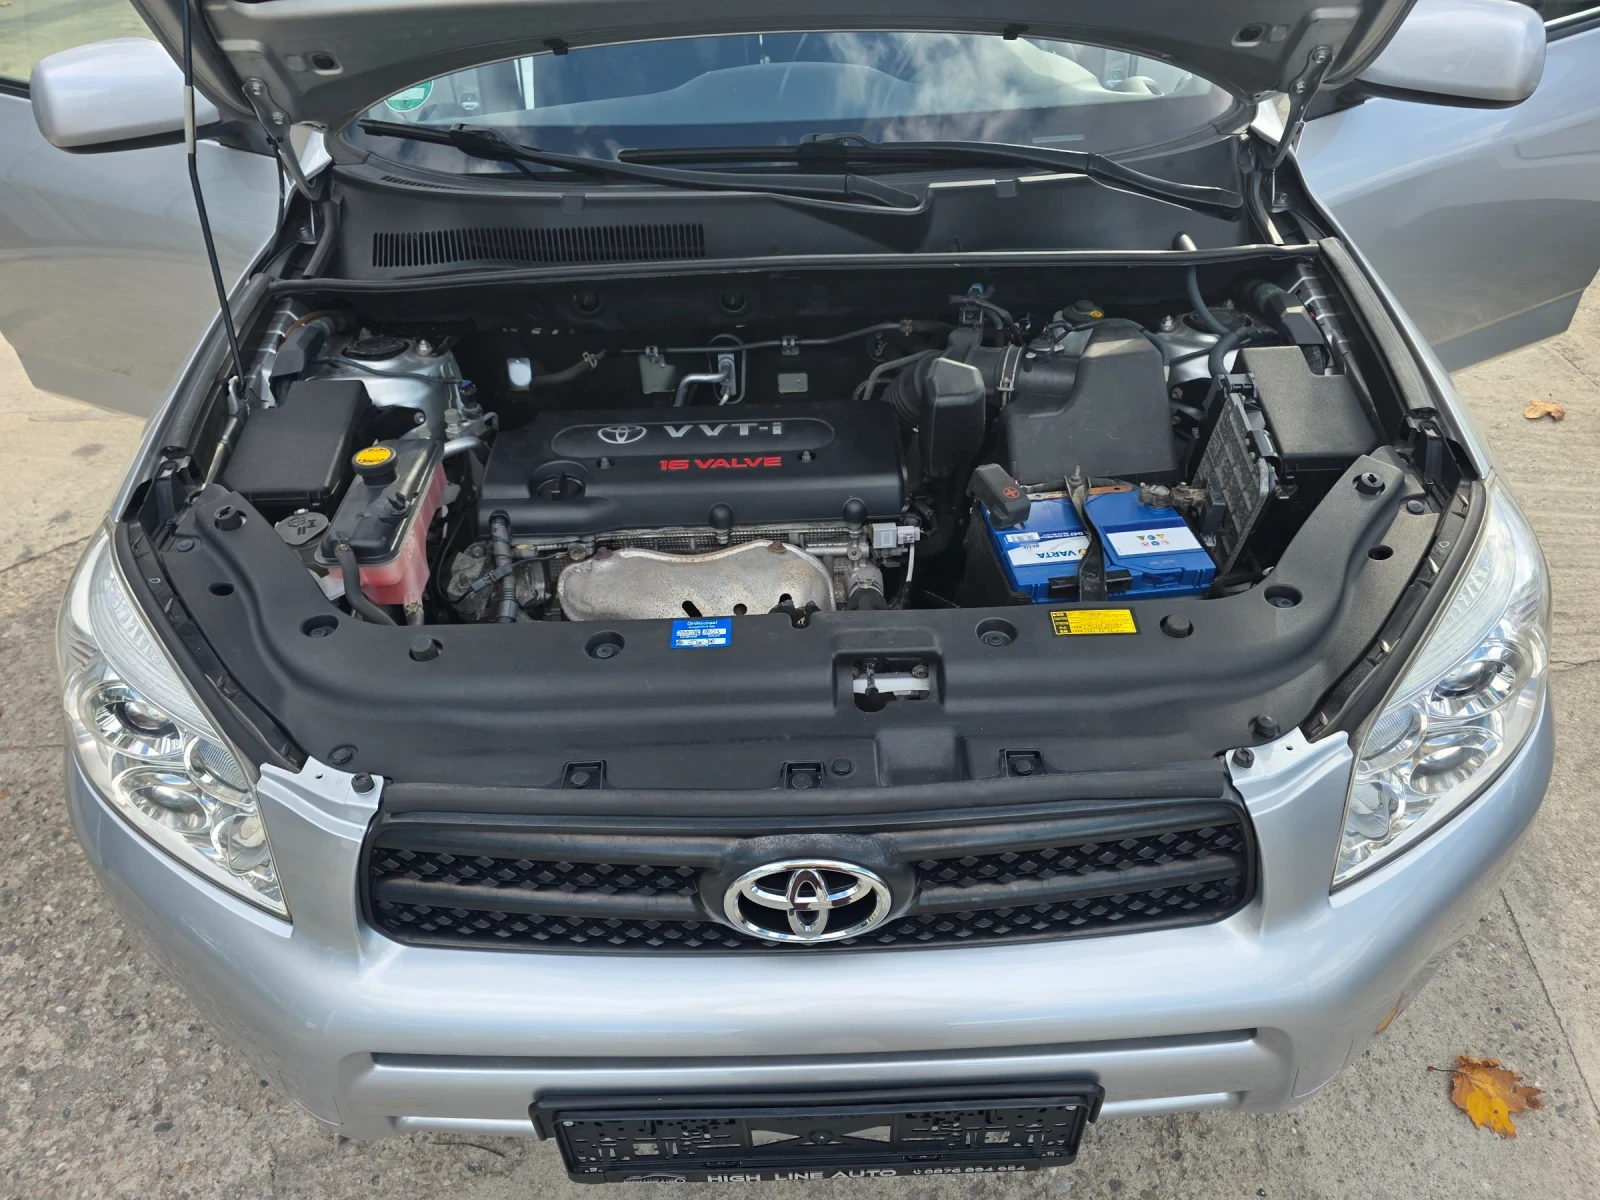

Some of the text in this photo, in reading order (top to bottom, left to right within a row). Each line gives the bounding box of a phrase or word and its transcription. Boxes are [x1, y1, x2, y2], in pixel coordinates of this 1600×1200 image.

[664, 422, 782, 438] VVT-i
[660, 456, 781, 470] 16 VALVE
[1036, 550, 1076, 559] VARTA
[707, 1168, 897, 1183] HIGH LINE AUTO
